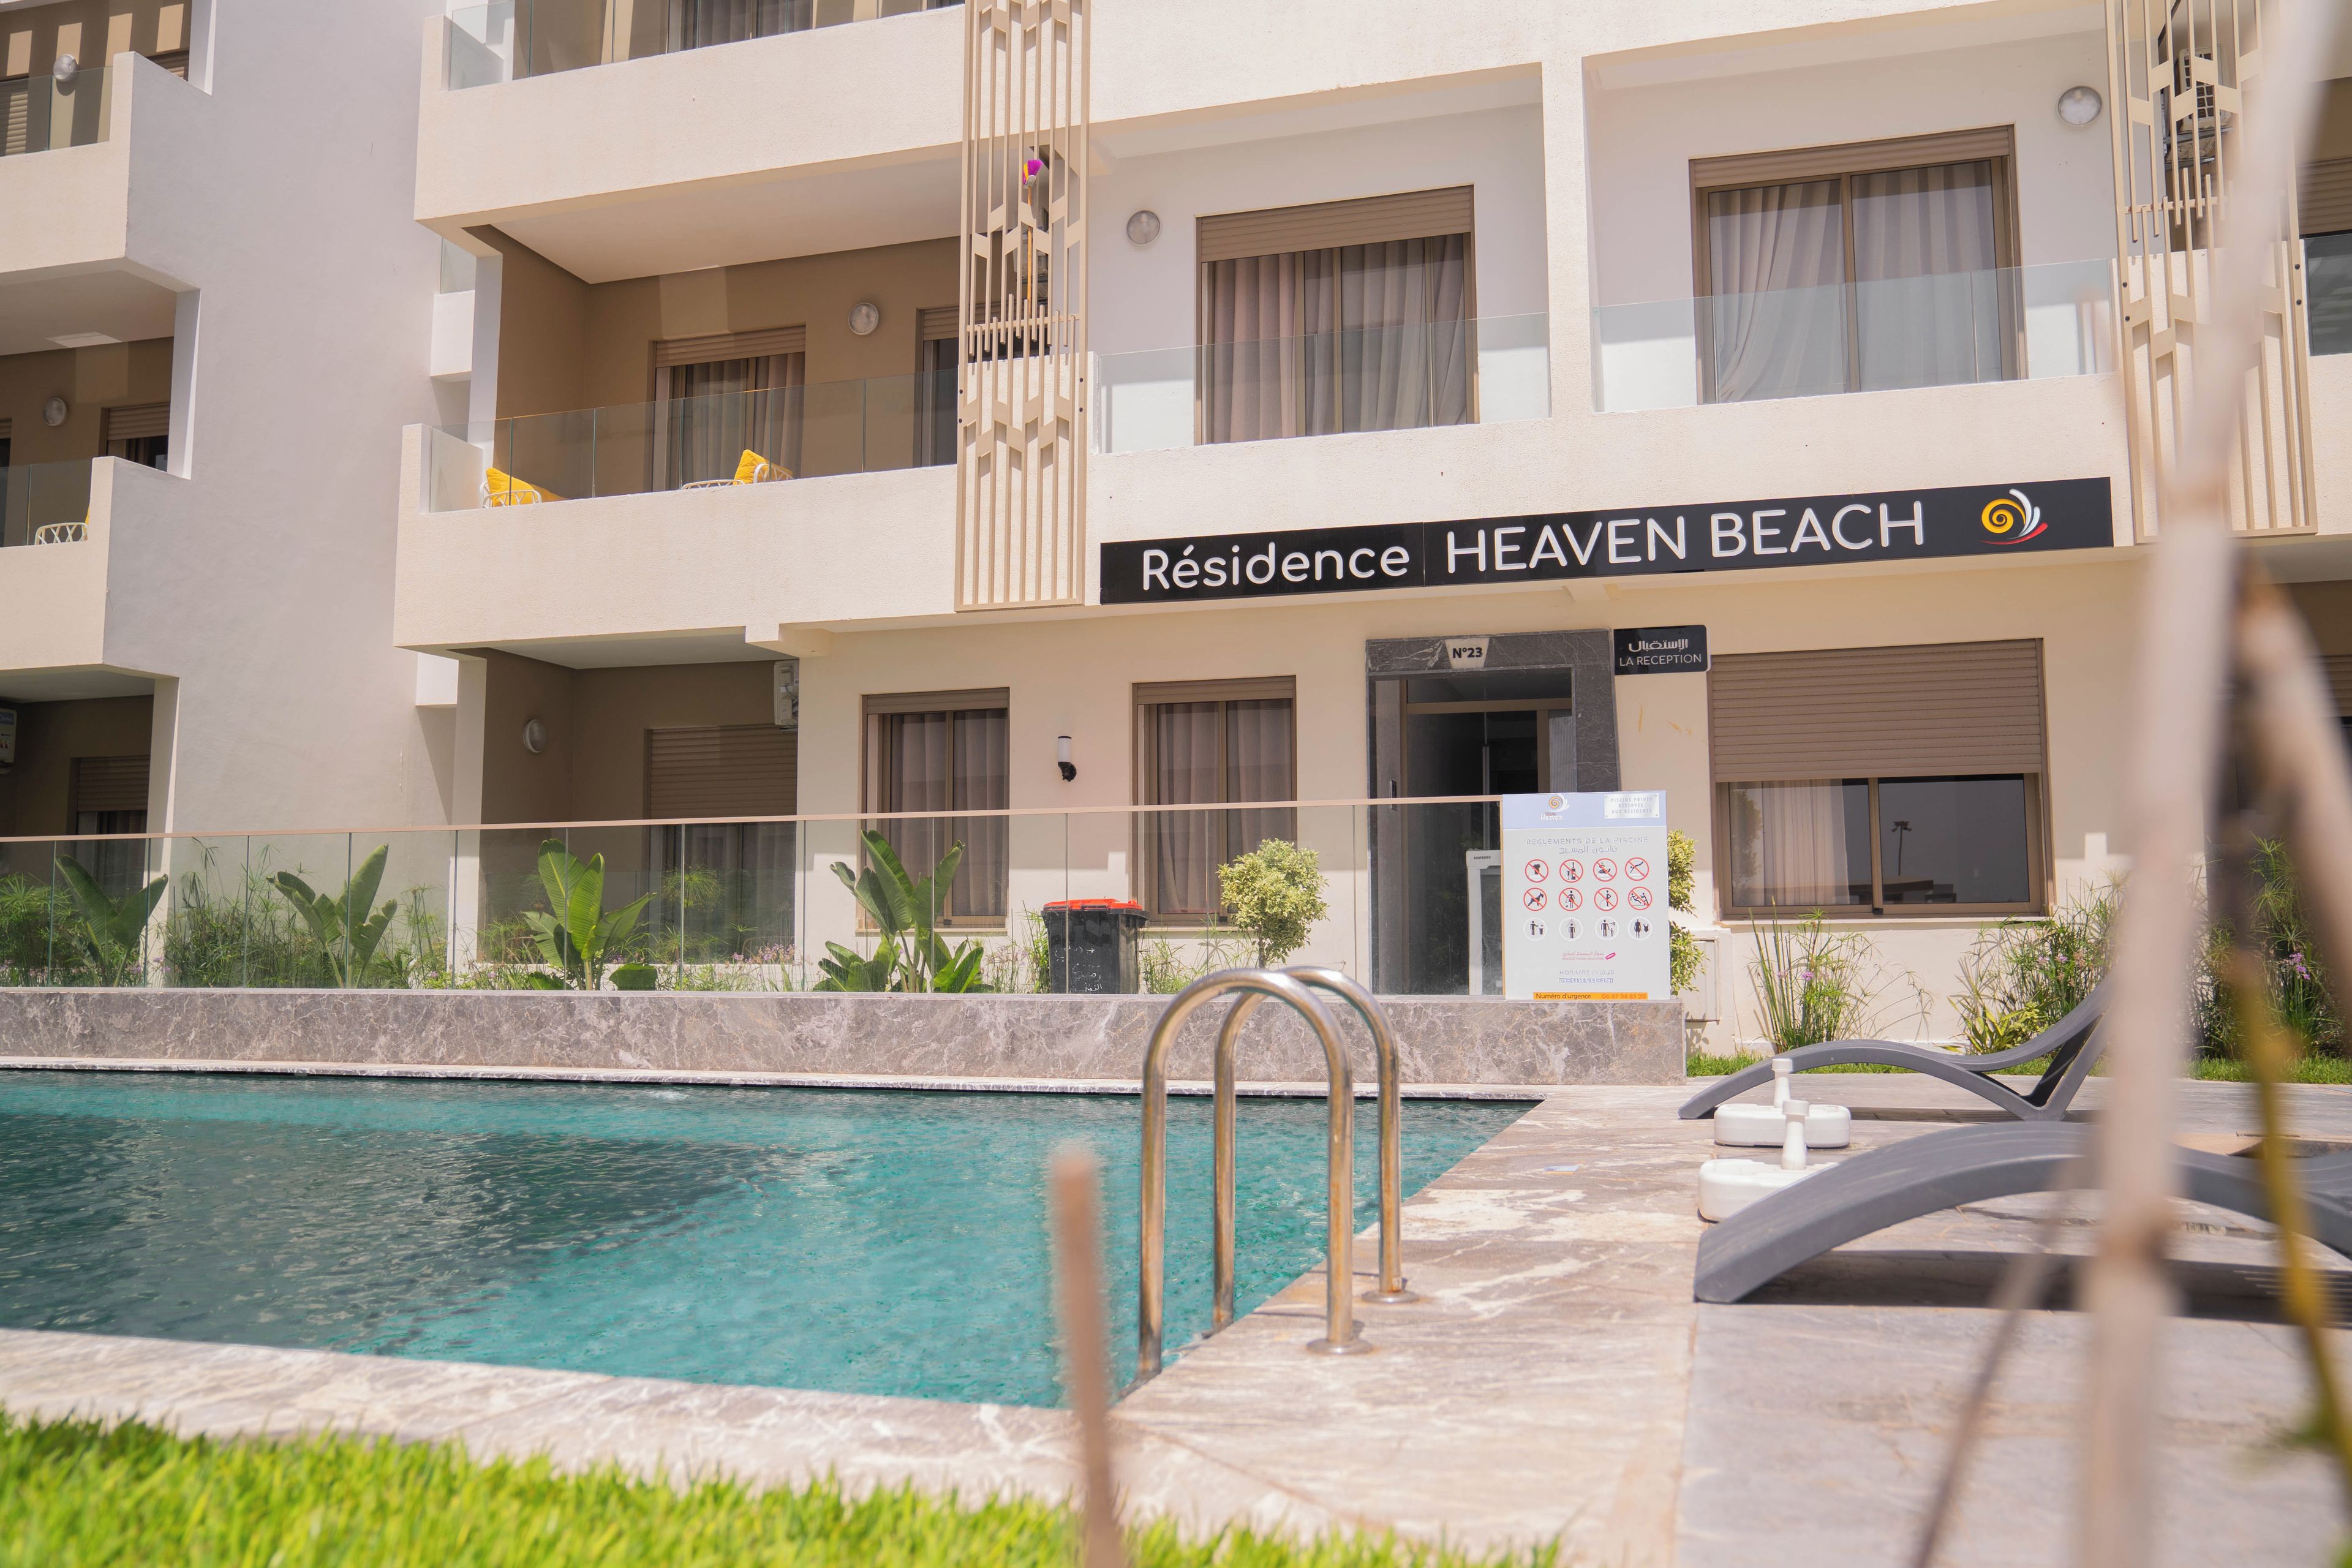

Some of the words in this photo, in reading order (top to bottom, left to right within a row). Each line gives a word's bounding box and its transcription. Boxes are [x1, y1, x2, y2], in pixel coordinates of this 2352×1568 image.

[1143, 542, 1409, 590] Résidence
[1447, 516, 1686, 574] HEAVEN
[1711, 500, 1923, 557] BEACH
[1452, 647, 1483, 658] N°23
[1619, 657, 1634, 666] LA
[1637, 654, 1702, 666] RECEPTION
